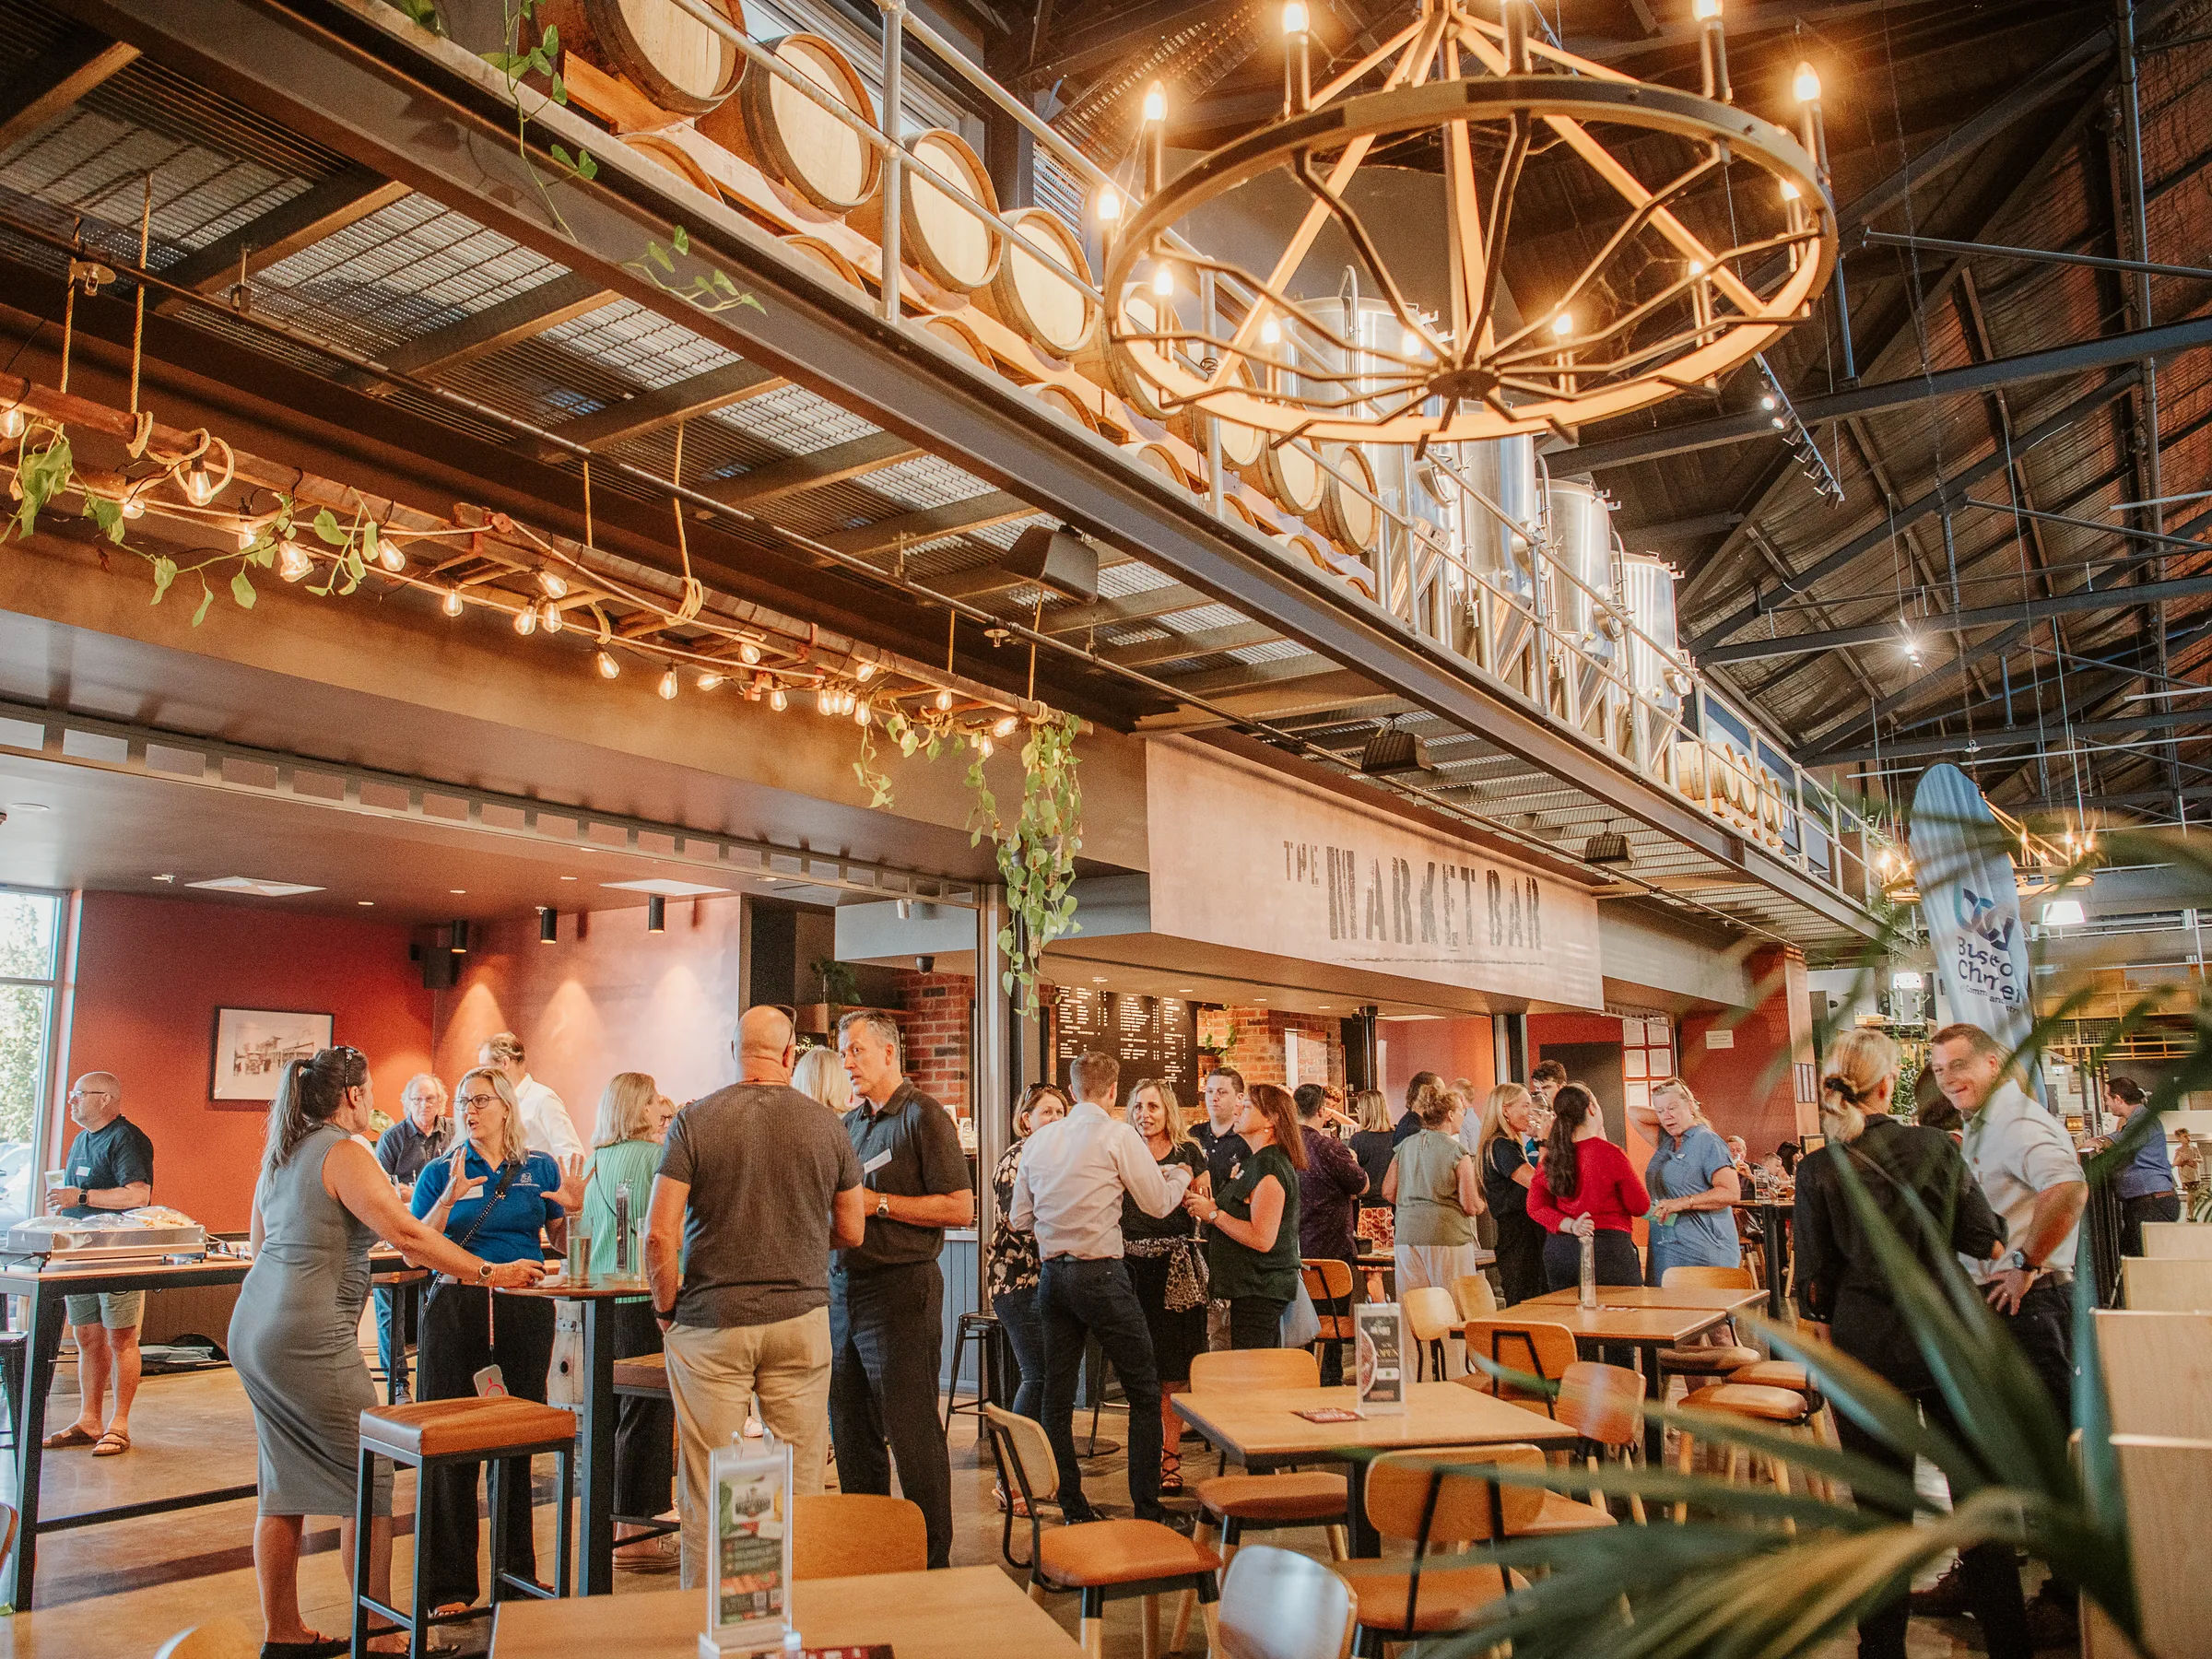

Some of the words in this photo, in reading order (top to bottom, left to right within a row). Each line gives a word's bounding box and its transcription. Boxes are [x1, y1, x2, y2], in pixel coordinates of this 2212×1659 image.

[1283, 840, 1320, 887] THE
[1325, 845, 1477, 949] MARKET
[1486, 868, 1542, 950] BAR
